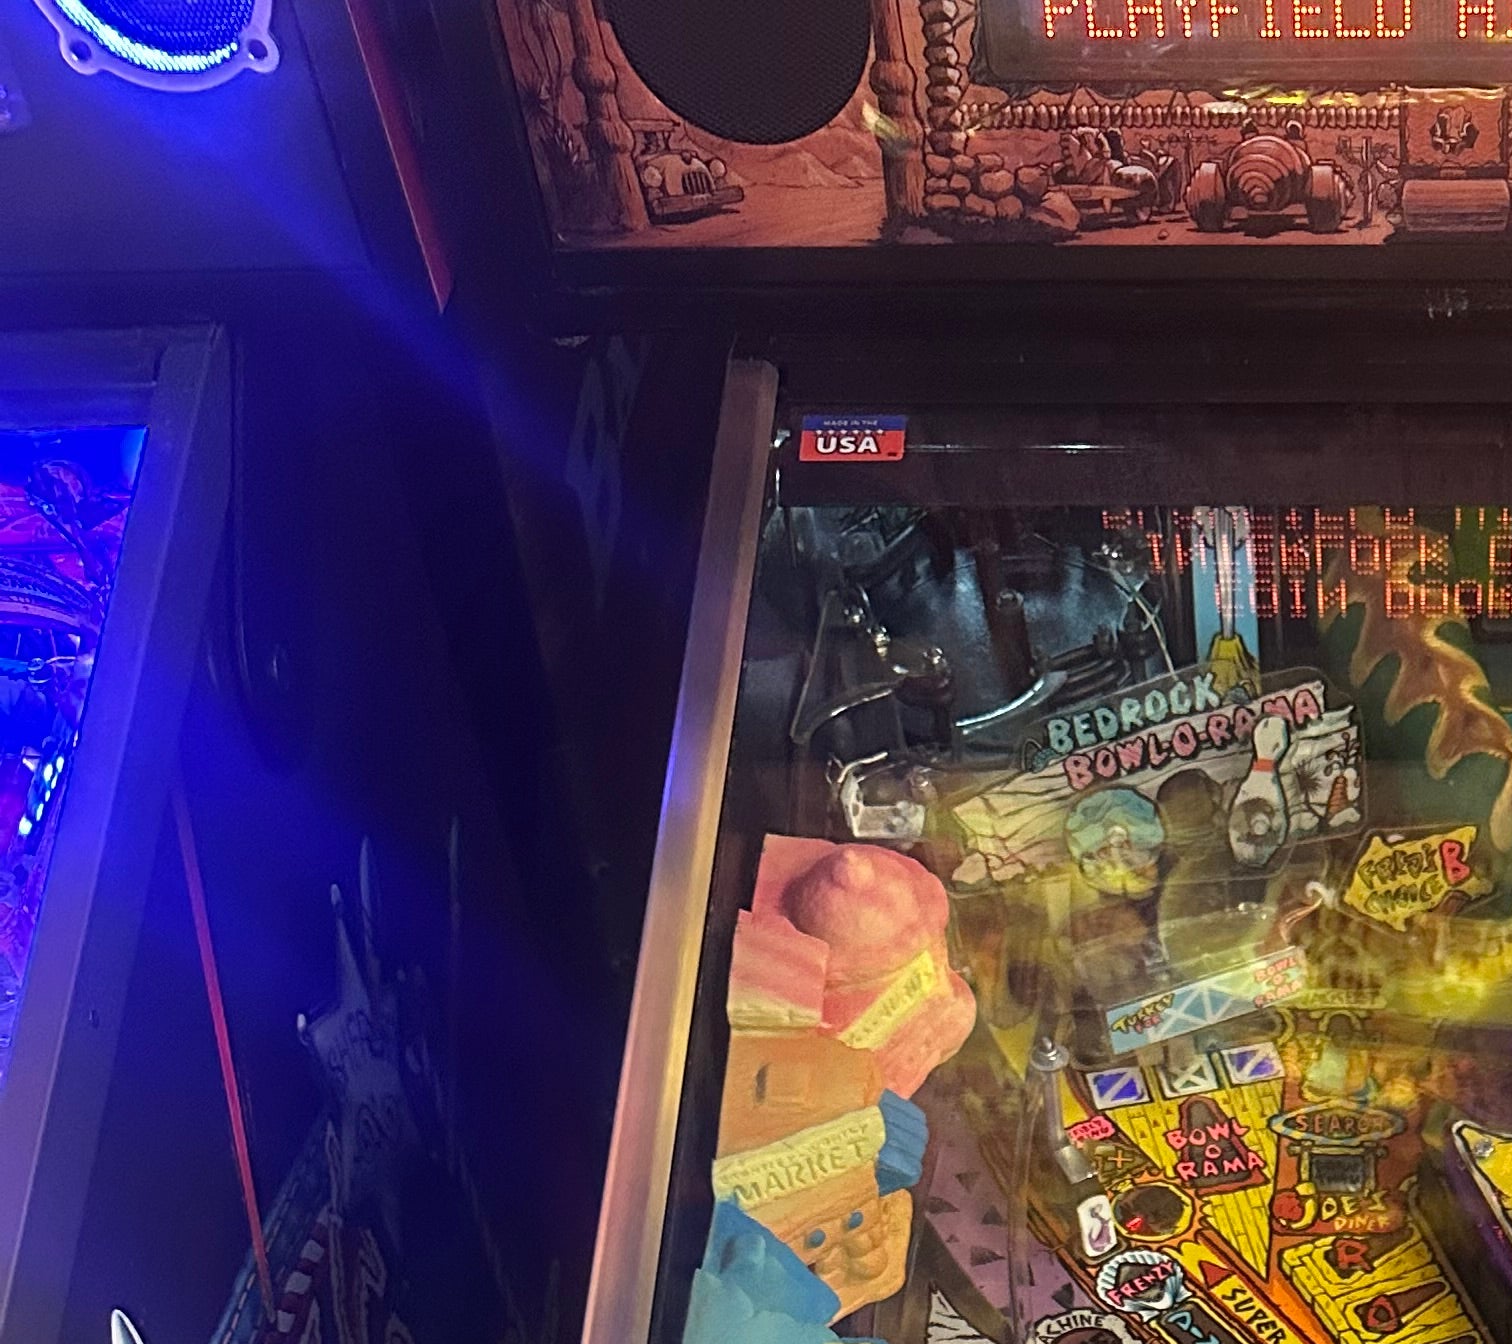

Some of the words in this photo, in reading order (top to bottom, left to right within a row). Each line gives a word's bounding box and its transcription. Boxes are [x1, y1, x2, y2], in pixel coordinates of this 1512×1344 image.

[816, 436, 879, 454] USA
[1048, 672, 1222, 755] BEDROCK
[1439, 839, 1471, 887] B
[1111, 993, 1176, 1033] TURKEY
[1166, 1118, 1250, 1151] BOWL
[1295, 1114, 1386, 1134] SEARCH
[733, 1136, 871, 1201] MARKET
[1179, 1151, 1266, 1183] RAMA
[1108, 1262, 1182, 1306] FRENZY
